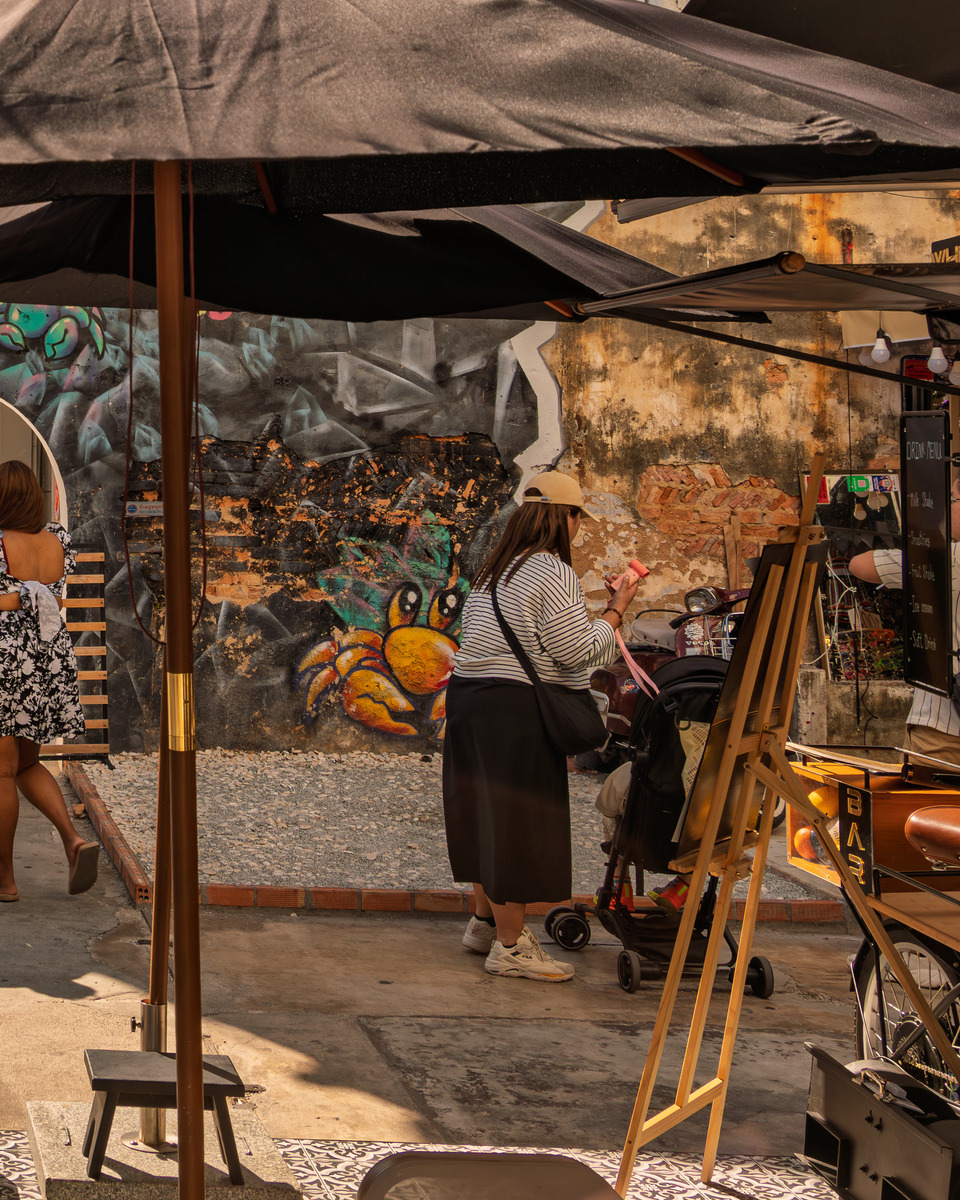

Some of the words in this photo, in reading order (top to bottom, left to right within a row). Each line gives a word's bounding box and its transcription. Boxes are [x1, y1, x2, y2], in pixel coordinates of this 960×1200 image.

[906, 441, 926, 461] DRINK
[926, 441, 943, 460] MENU
[846, 787, 866, 885] BAR
